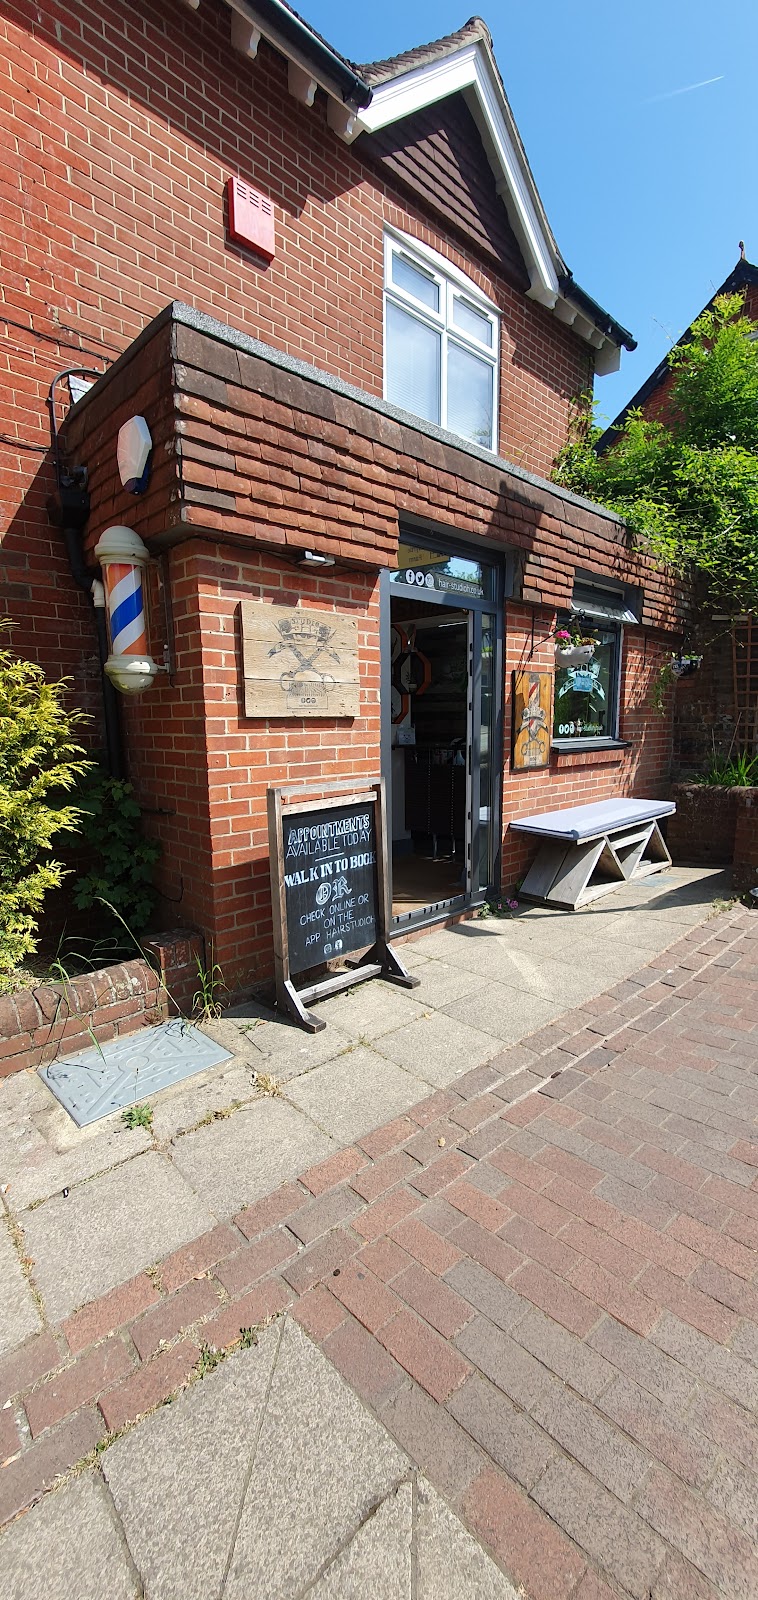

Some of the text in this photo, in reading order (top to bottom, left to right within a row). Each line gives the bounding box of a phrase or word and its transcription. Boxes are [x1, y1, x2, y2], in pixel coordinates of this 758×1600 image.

[285, 829, 372, 860] AVAILABLE TODAY
[287, 813, 370, 845] APPOINTMENTS
[284, 851, 377, 888] WALK IN TO BOOK
[315, 875, 352, 905] OR
[299, 893, 369, 926] CHECK ONLINE OR
[323, 909, 354, 929] ON THE
[305, 932, 321, 947] APP
